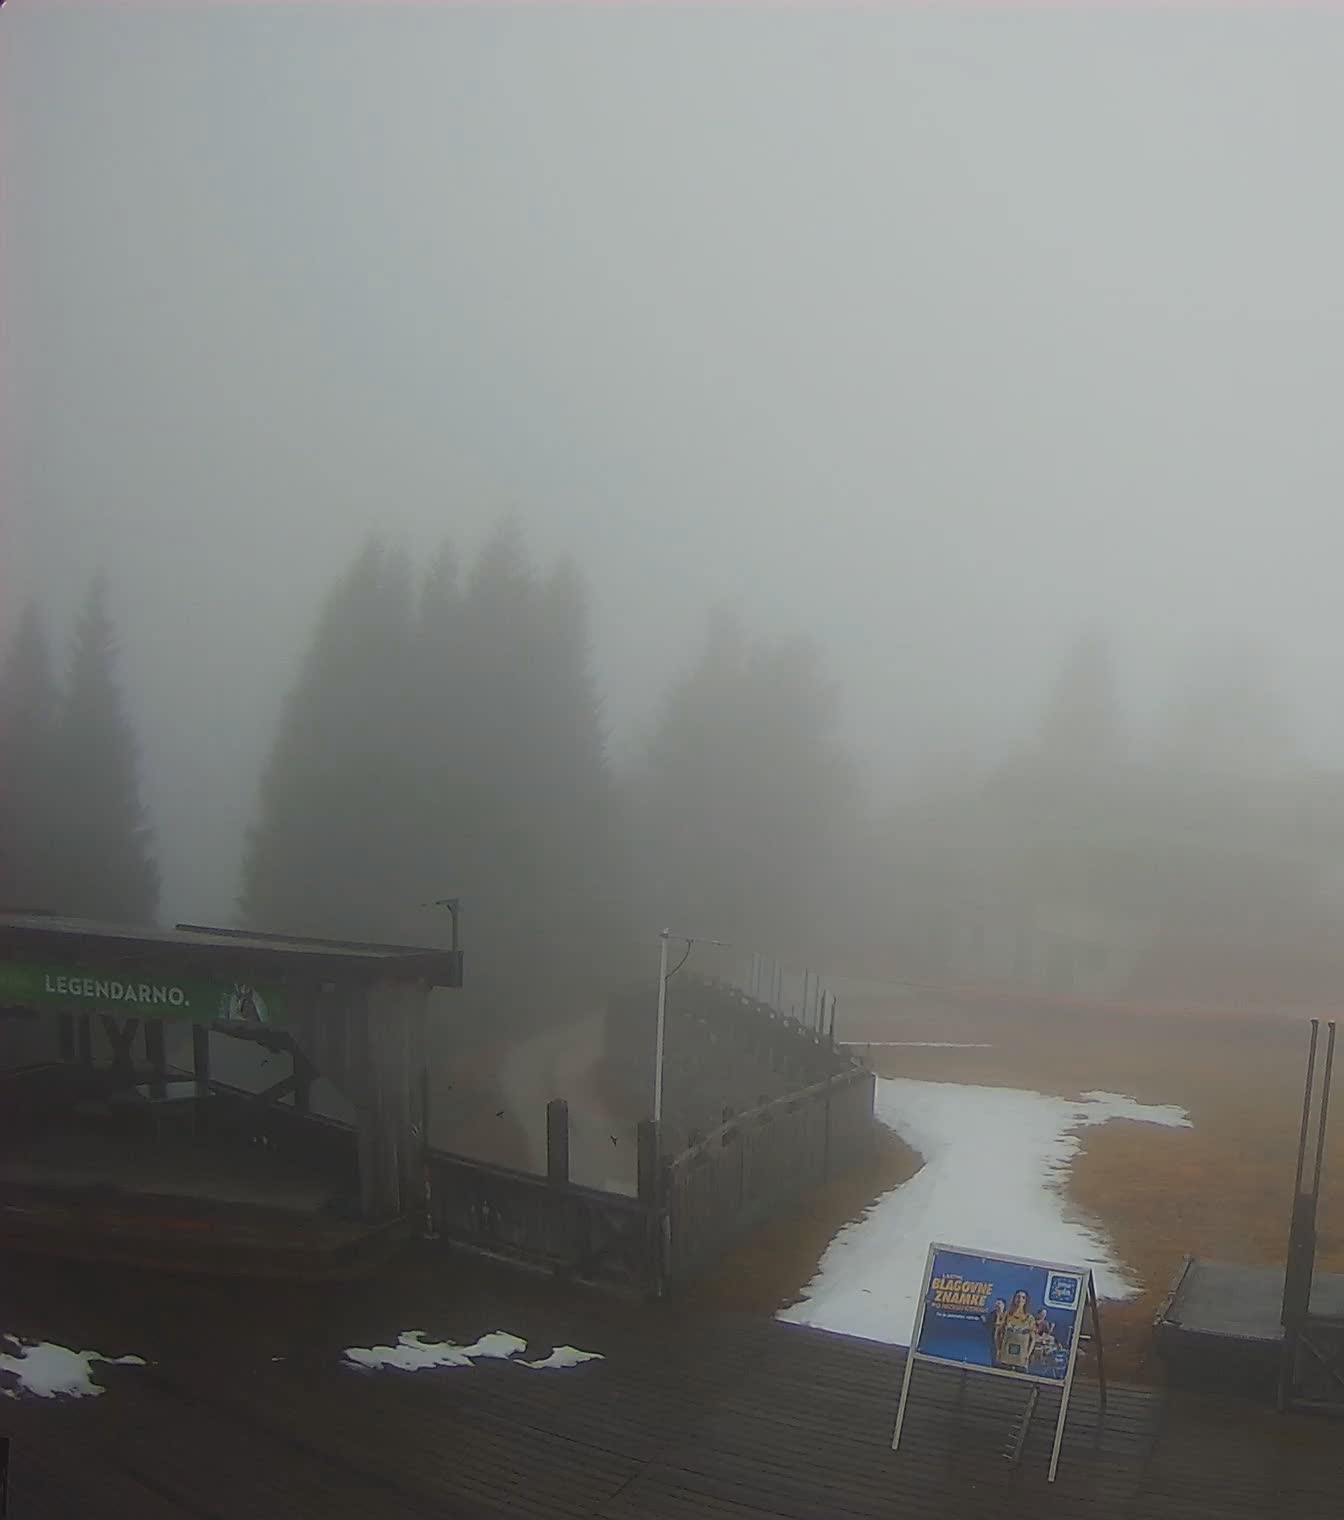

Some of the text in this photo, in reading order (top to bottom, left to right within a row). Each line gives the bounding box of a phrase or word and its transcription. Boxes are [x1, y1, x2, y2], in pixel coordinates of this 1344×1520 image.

[45, 974, 190, 1007] LEGENDARNO.
[932, 1278, 993, 1296] BLAGOVNE
[935, 1290, 987, 1307] ZNAMKE
